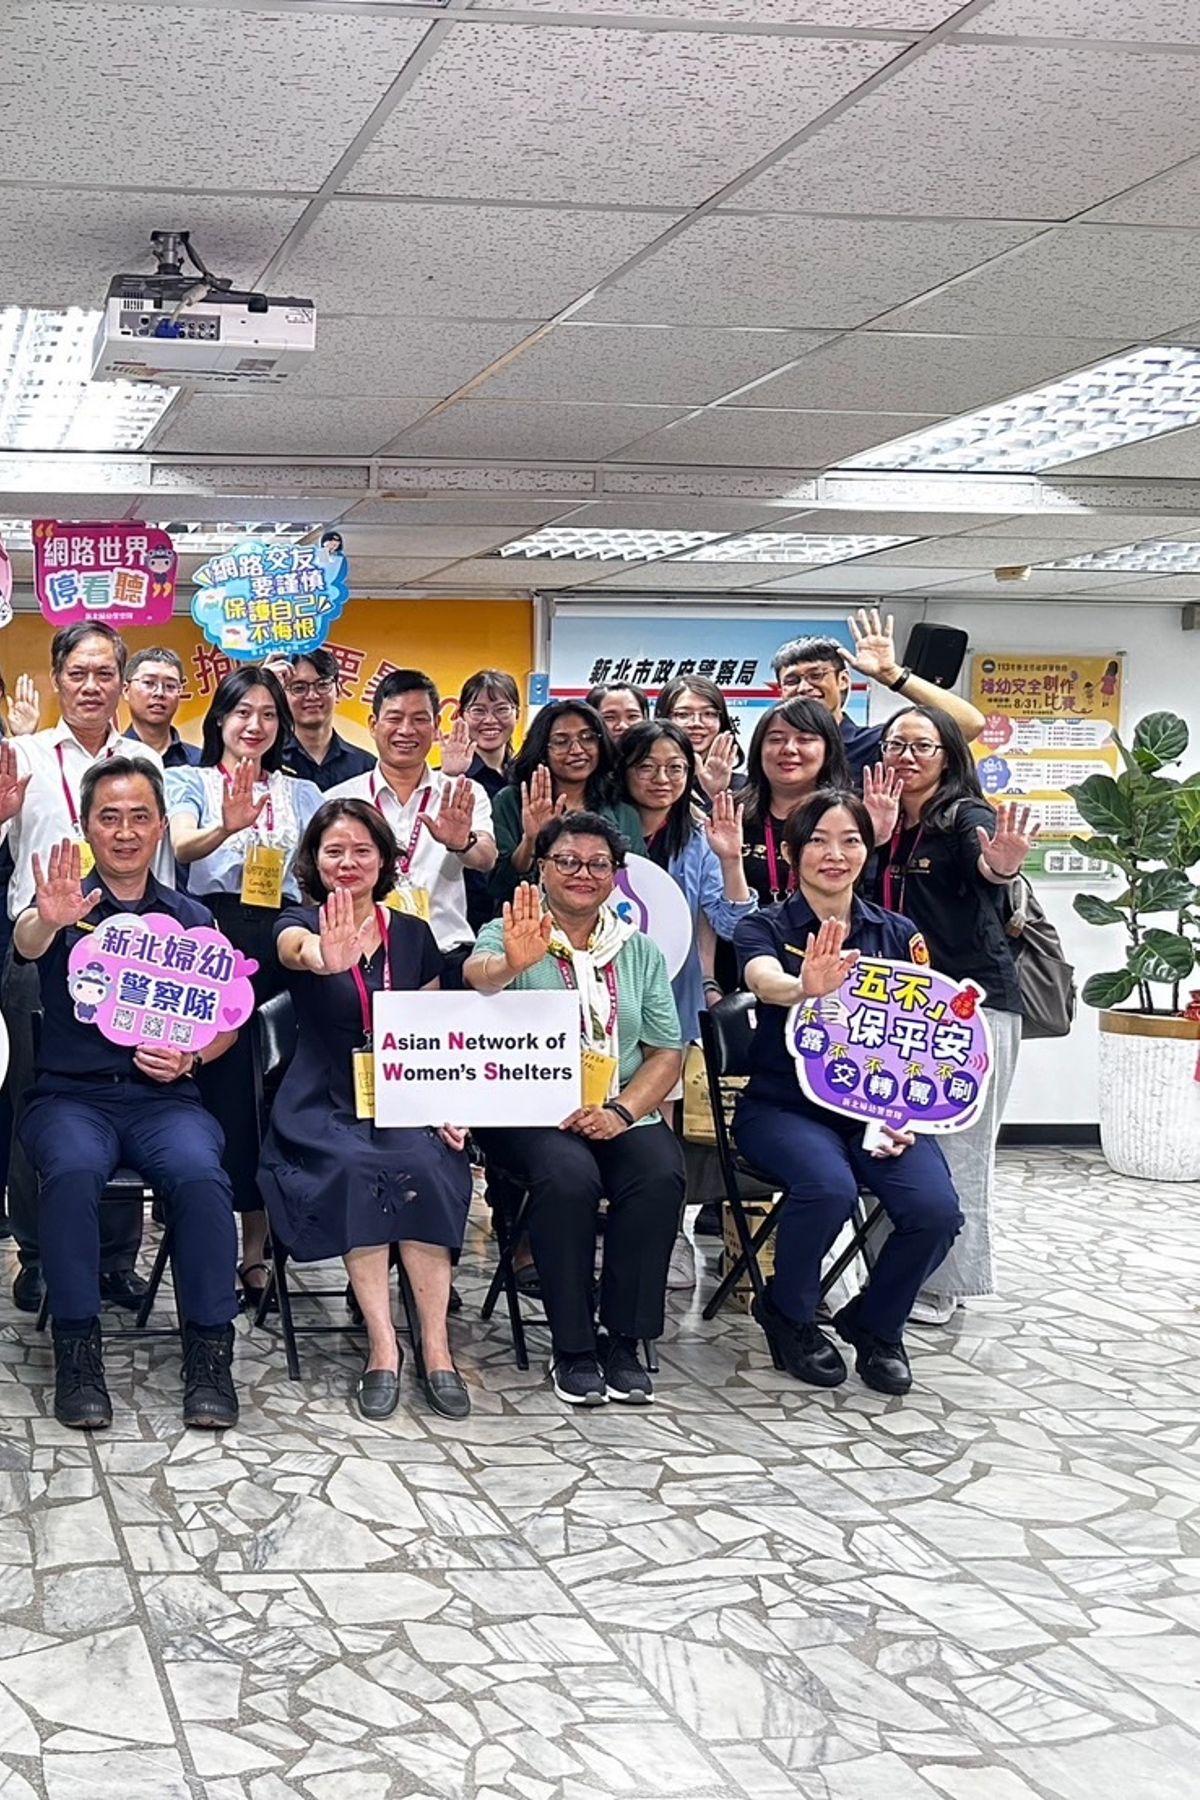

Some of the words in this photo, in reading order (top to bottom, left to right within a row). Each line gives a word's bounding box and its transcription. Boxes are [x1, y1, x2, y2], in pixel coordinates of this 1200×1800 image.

[43, 536, 148, 567] 網路世界
[212, 548, 314, 582] 網路交友
[48, 571, 146, 608] 停看聽
[251, 570, 324, 598] 要謹慎
[224, 594, 317, 621] 保護自己
[249, 617, 316, 643] 不悔恨
[588, 658, 758, 686] 新北市政府警察局
[101, 926, 234, 982] 新北婦幼
[119, 971, 217, 1021] 警察隊
[381, 1032, 441, 1050] Asian
[448, 1031, 540, 1050] Network
[545, 1032, 566, 1050] of
[849, 1005, 972, 1065] 保平安
[382, 1062, 477, 1081] Women’s
[484, 1062, 573, 1081] Shelters
